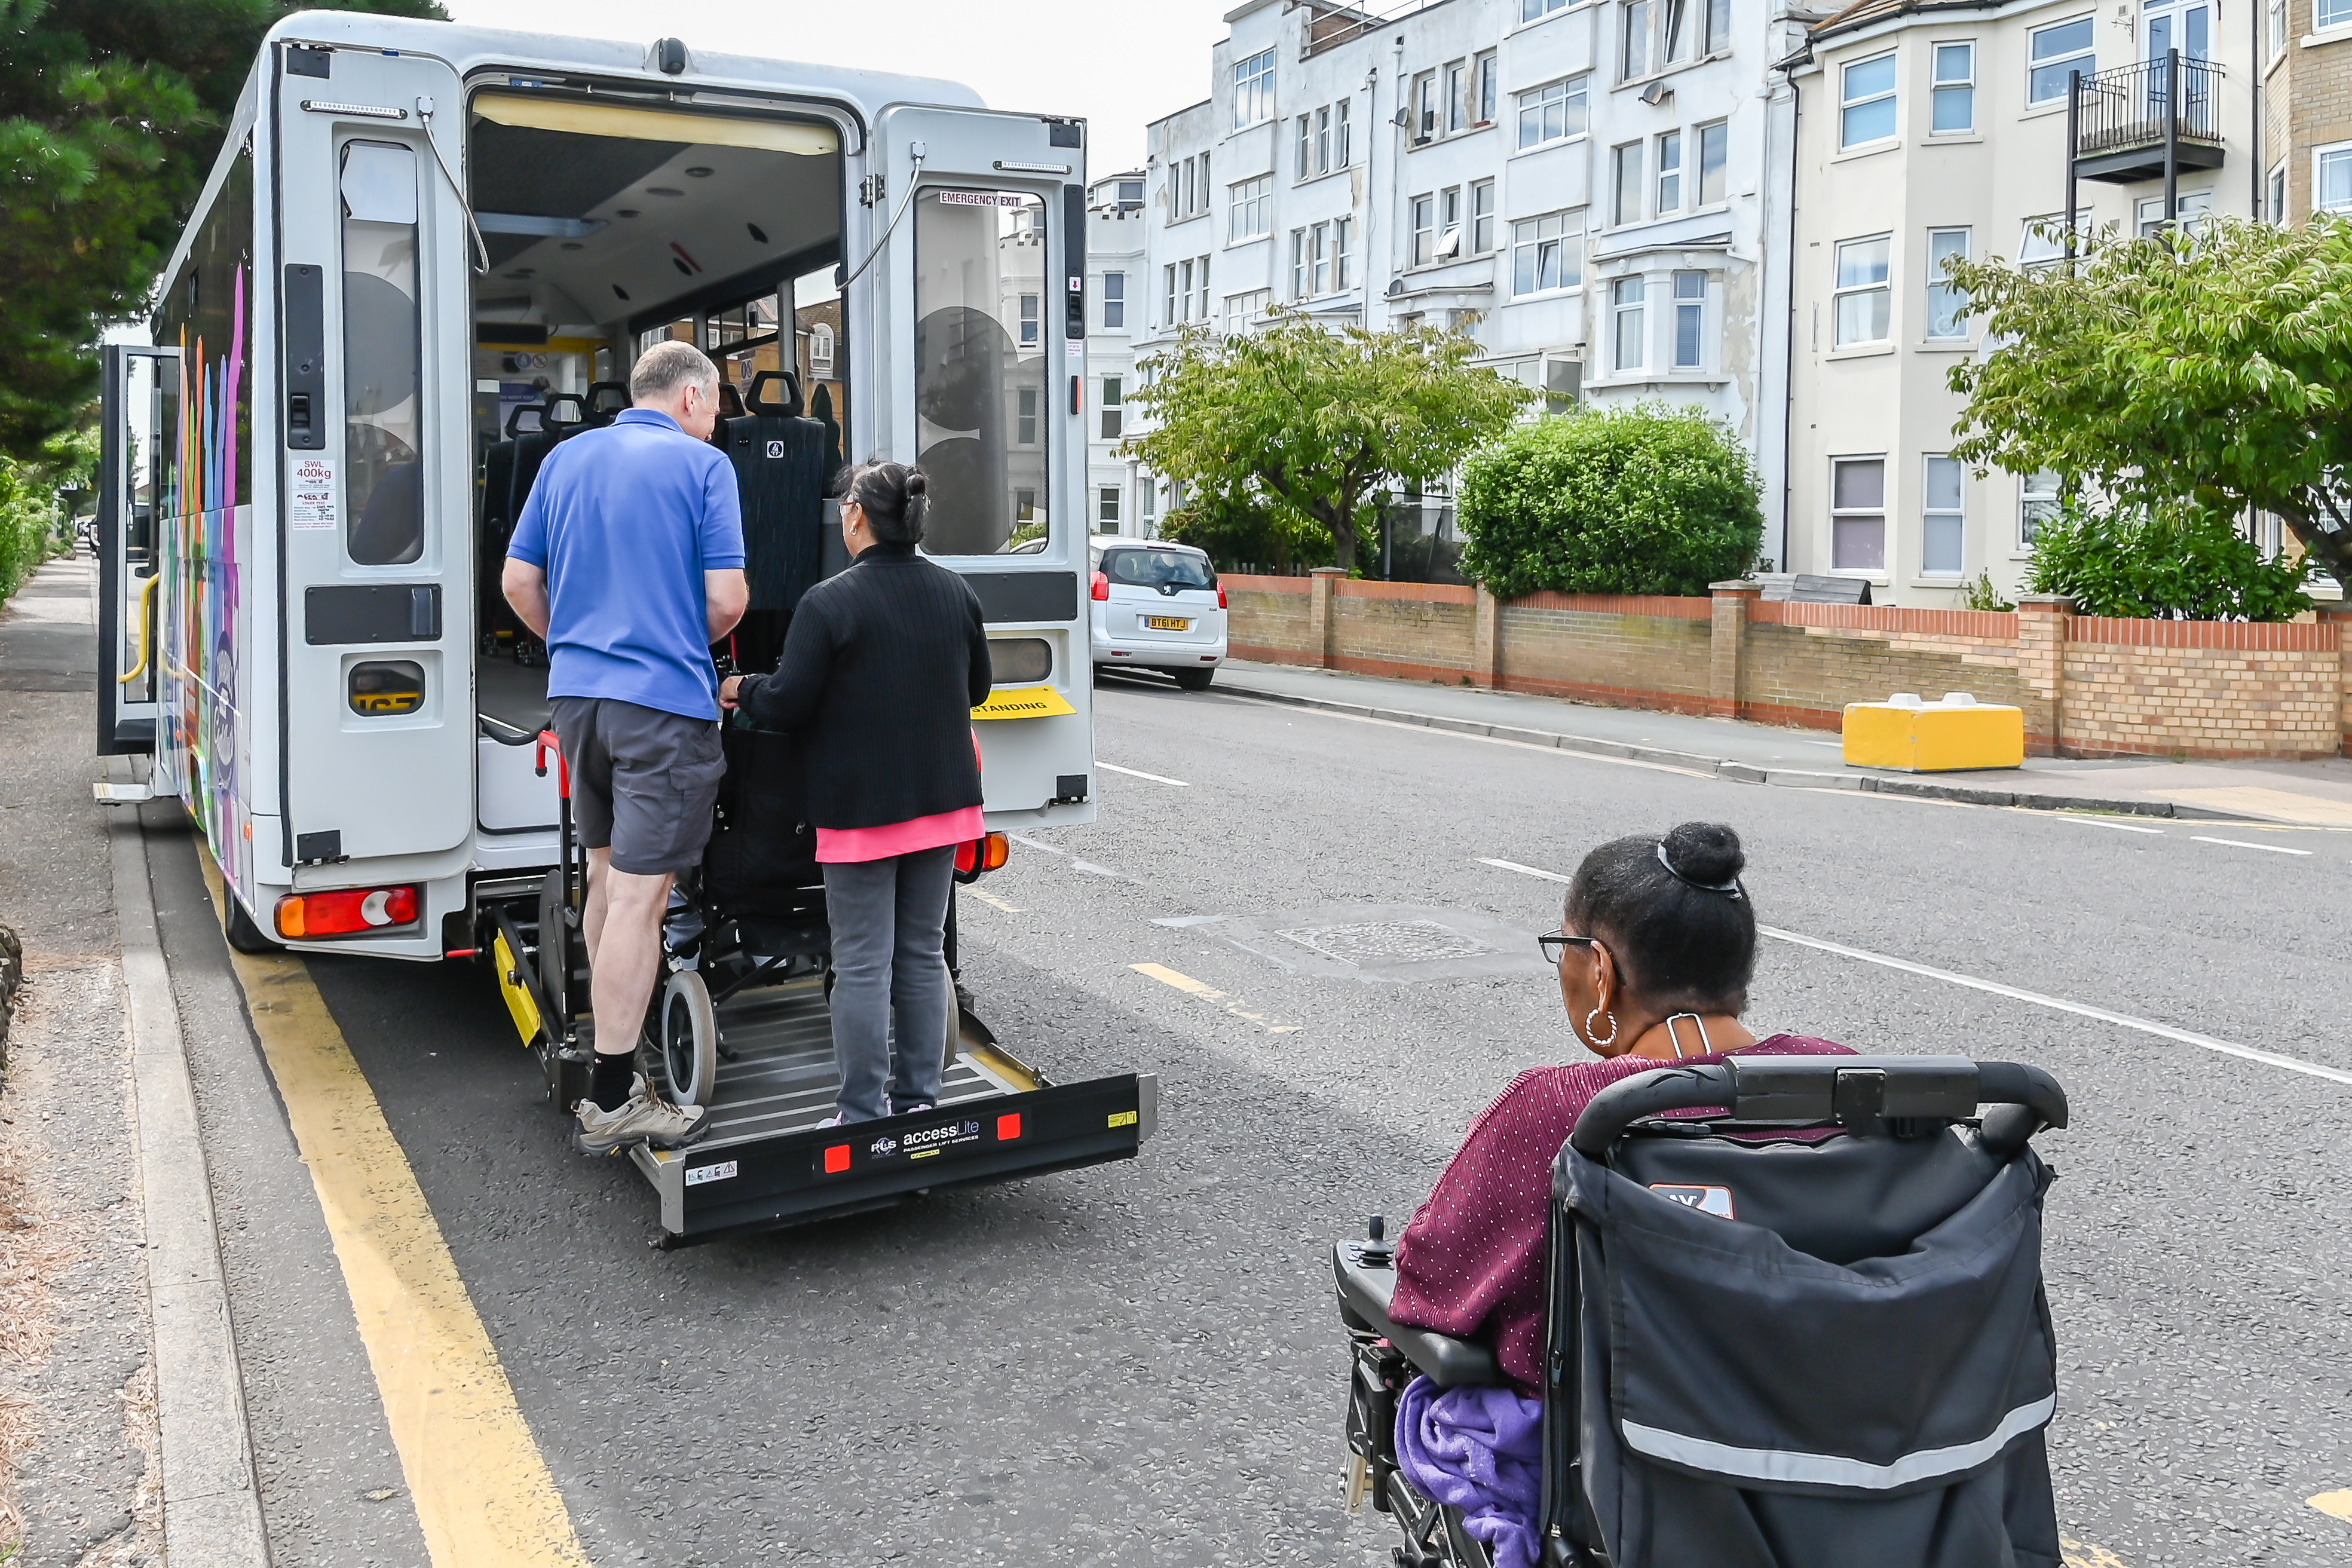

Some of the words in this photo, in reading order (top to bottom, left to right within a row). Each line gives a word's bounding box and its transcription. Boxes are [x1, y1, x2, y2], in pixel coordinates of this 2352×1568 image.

[942, 192, 997, 206] EMERGENCY
[1000, 196, 1020, 207] EXIT
[296, 468, 331, 480] 400kg
[1152, 618, 1169, 627] BT61
[1171, 619, 1186, 628] HTJ
[971, 702, 1048, 713] STANDING
[904, 1120, 979, 1146] accessLite
[871, 1140, 897, 1153] RLS
[903, 1143, 938, 1153] PASSENGER
[951, 1135, 979, 1144] SERVICES
